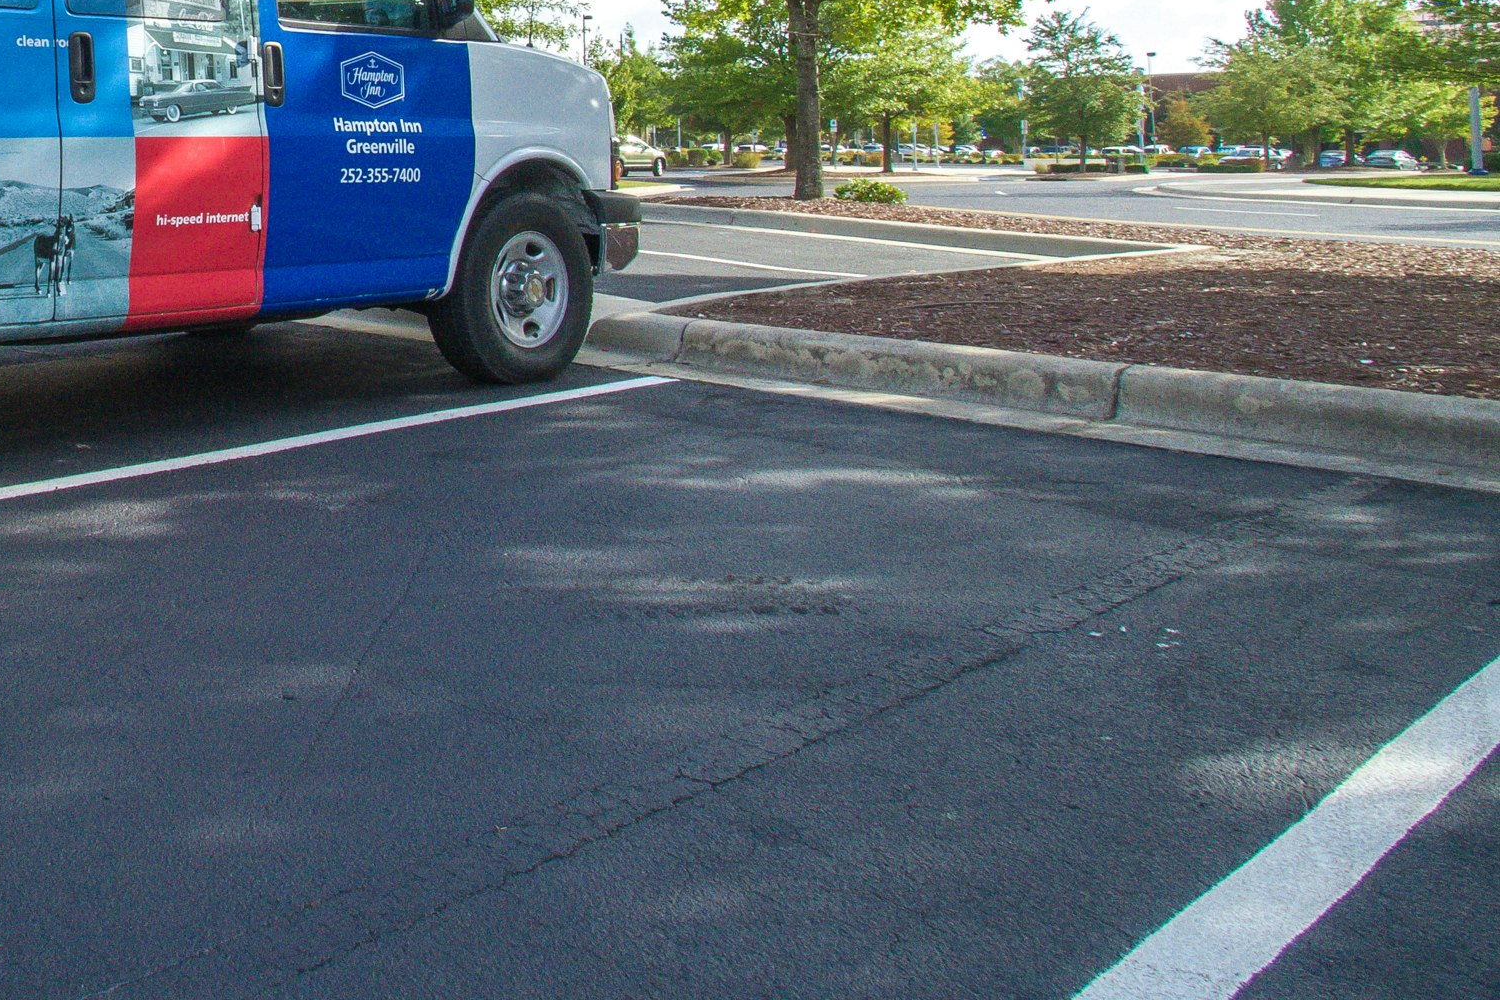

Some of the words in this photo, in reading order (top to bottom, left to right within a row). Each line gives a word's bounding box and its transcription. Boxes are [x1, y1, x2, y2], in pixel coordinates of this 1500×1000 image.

[16, 34, 50, 48] clean
[347, 67, 399, 85] Hampton
[360, 82, 386, 99] Inn
[333, 117, 398, 136] Hampton
[401, 119, 422, 133] Inn
[346, 138, 415, 154] Greenville
[340, 168, 421, 183] 252-355-7400
[156, 213, 203, 227] hi-speed
[205, 211, 250, 224] internet
